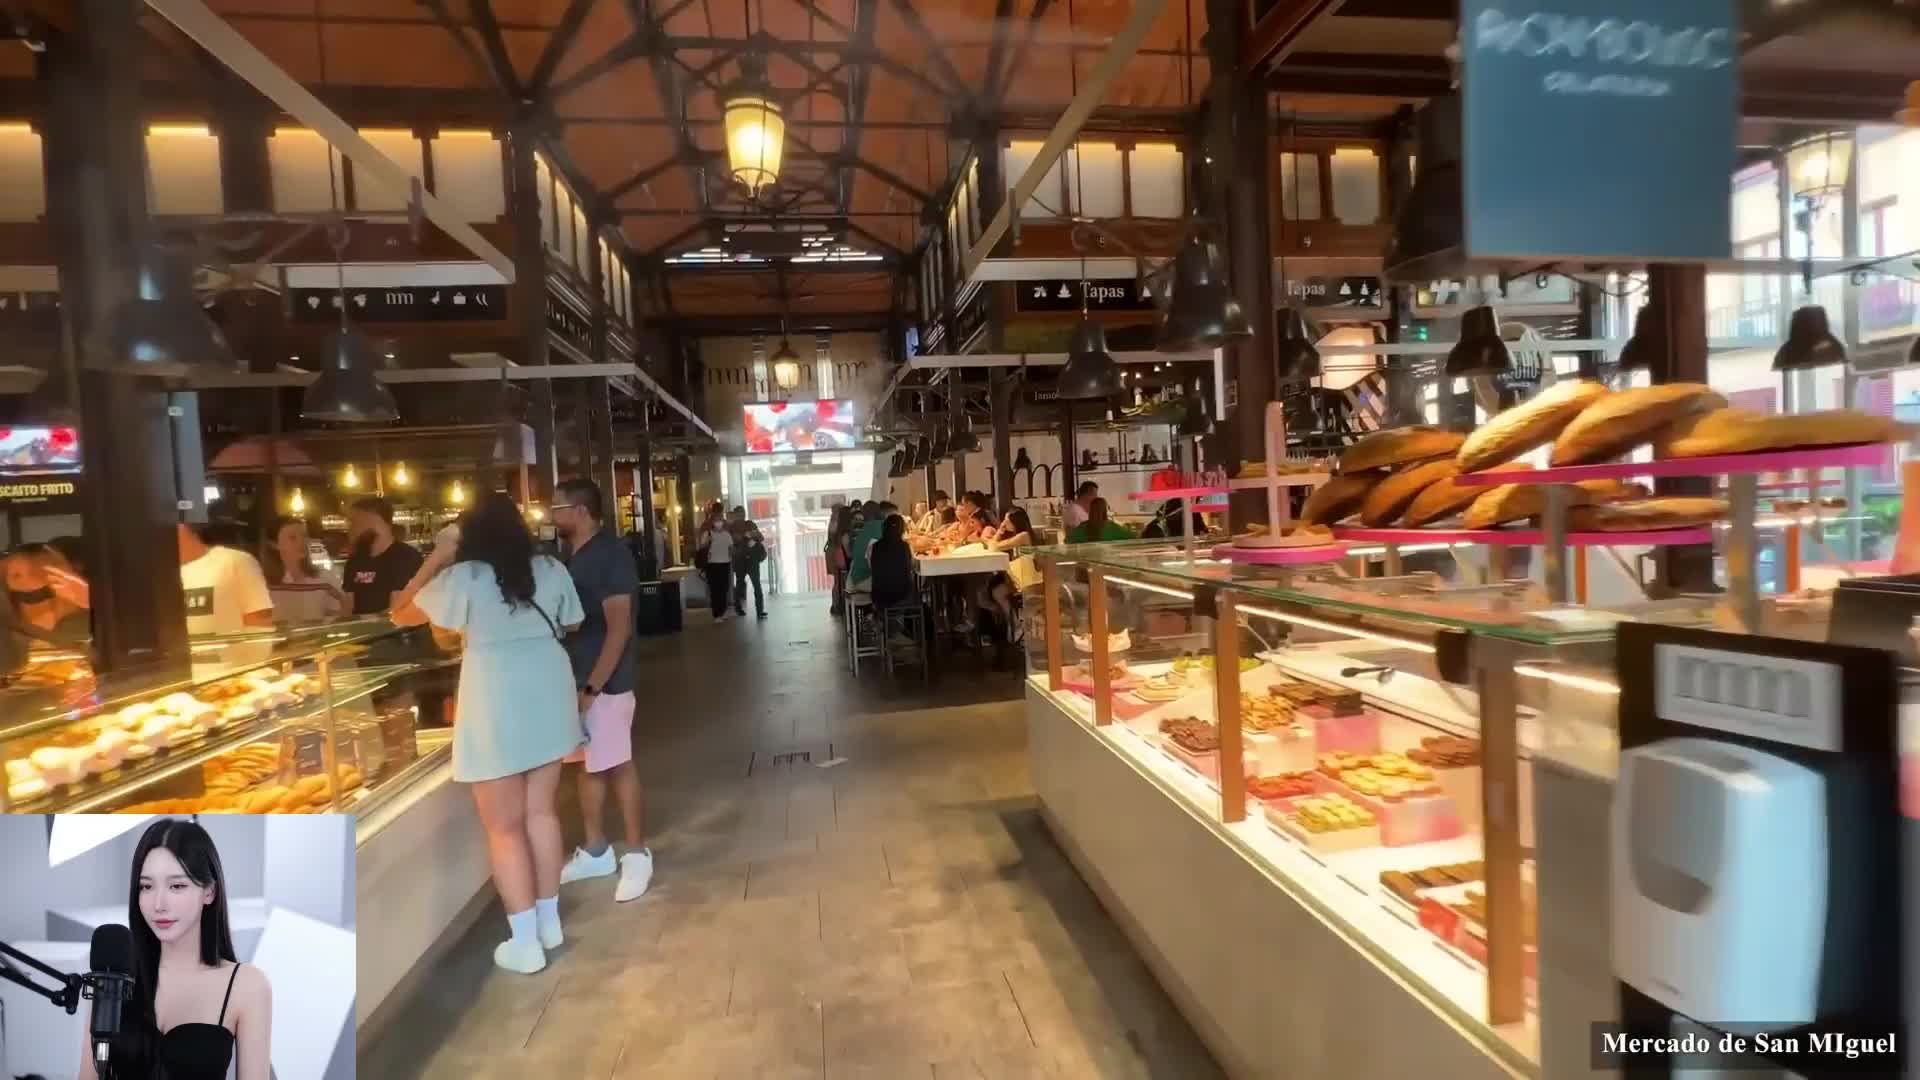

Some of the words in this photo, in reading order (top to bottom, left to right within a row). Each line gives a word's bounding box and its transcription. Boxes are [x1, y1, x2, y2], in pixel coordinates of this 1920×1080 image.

[1080, 282, 1125, 304] Tapas
[1287, 279, 1326, 301] Tapas
[40, 482, 74, 496] FRITO
